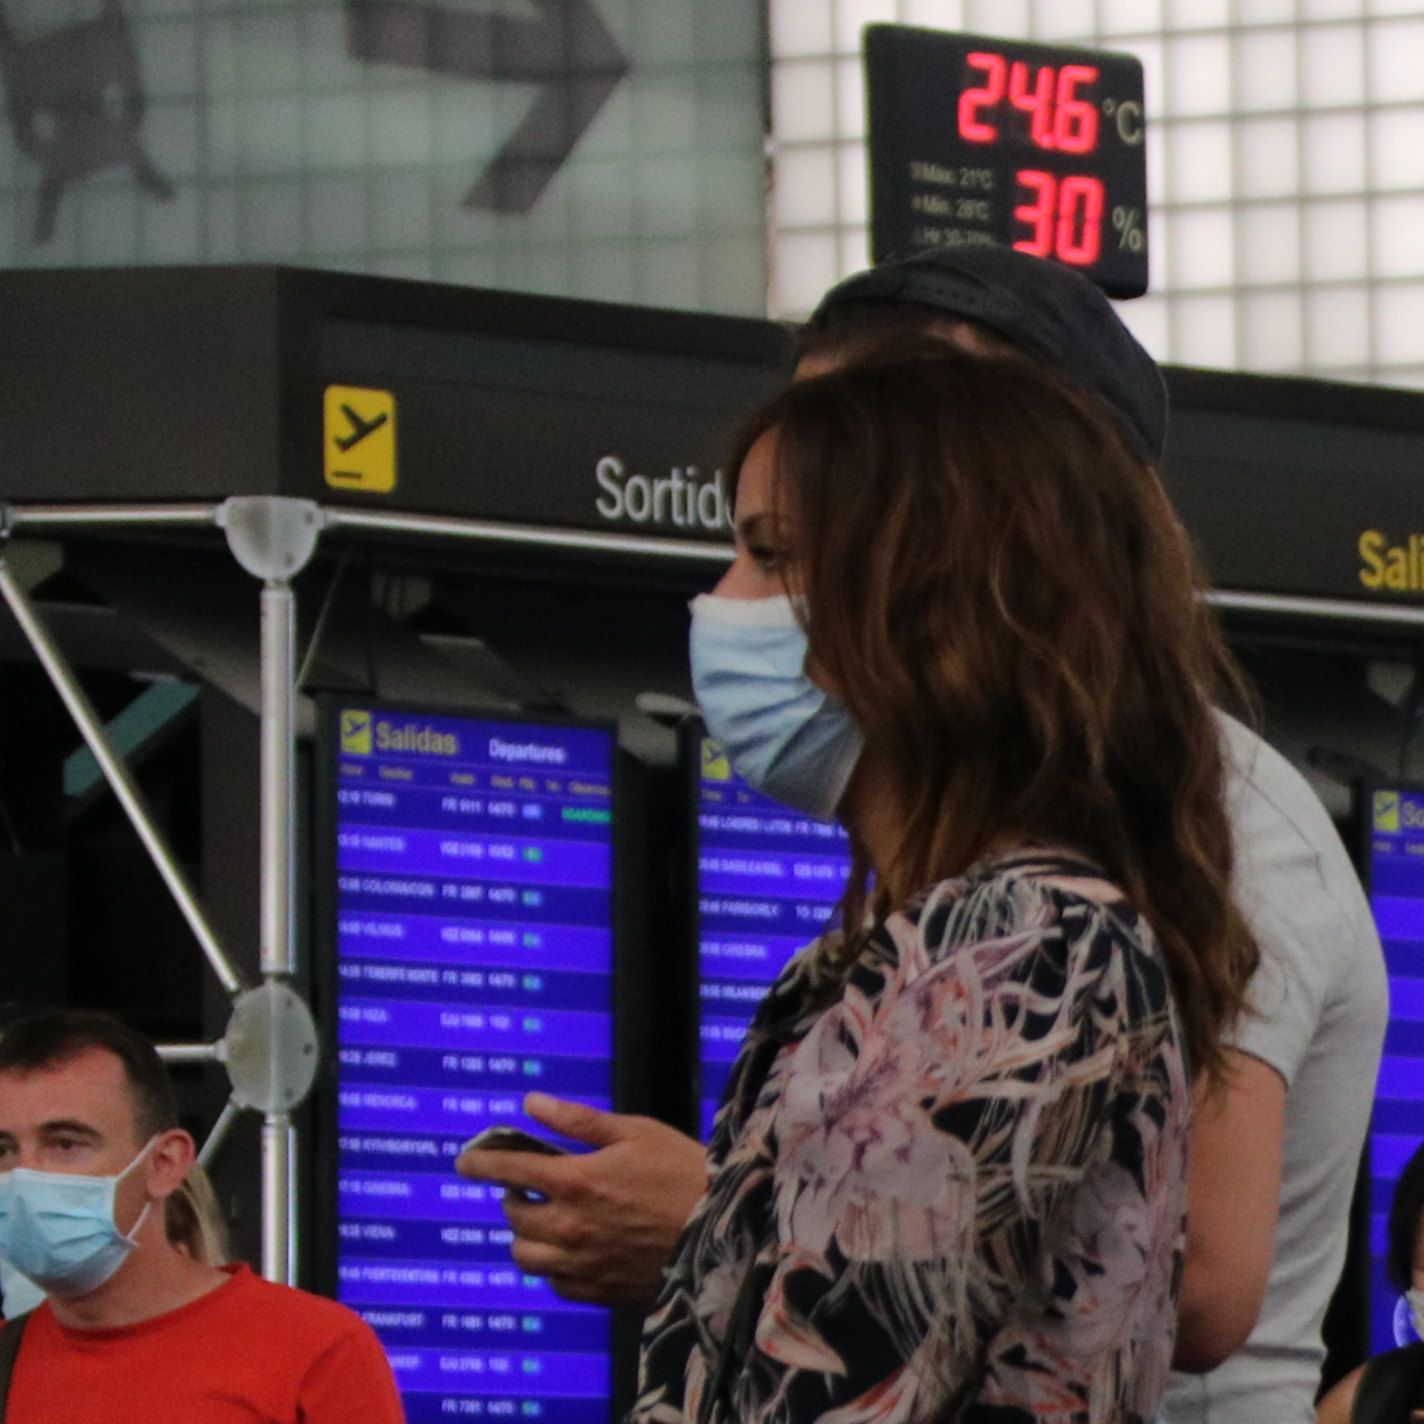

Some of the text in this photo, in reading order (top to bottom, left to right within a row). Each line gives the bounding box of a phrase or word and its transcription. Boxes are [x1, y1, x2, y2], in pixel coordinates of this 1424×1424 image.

[957, 51, 1101, 156] 24.6
[1012, 165, 1105, 267] 30
[596, 456, 734, 532] Sortid
[375, 720, 567, 765] Salidas Departures
